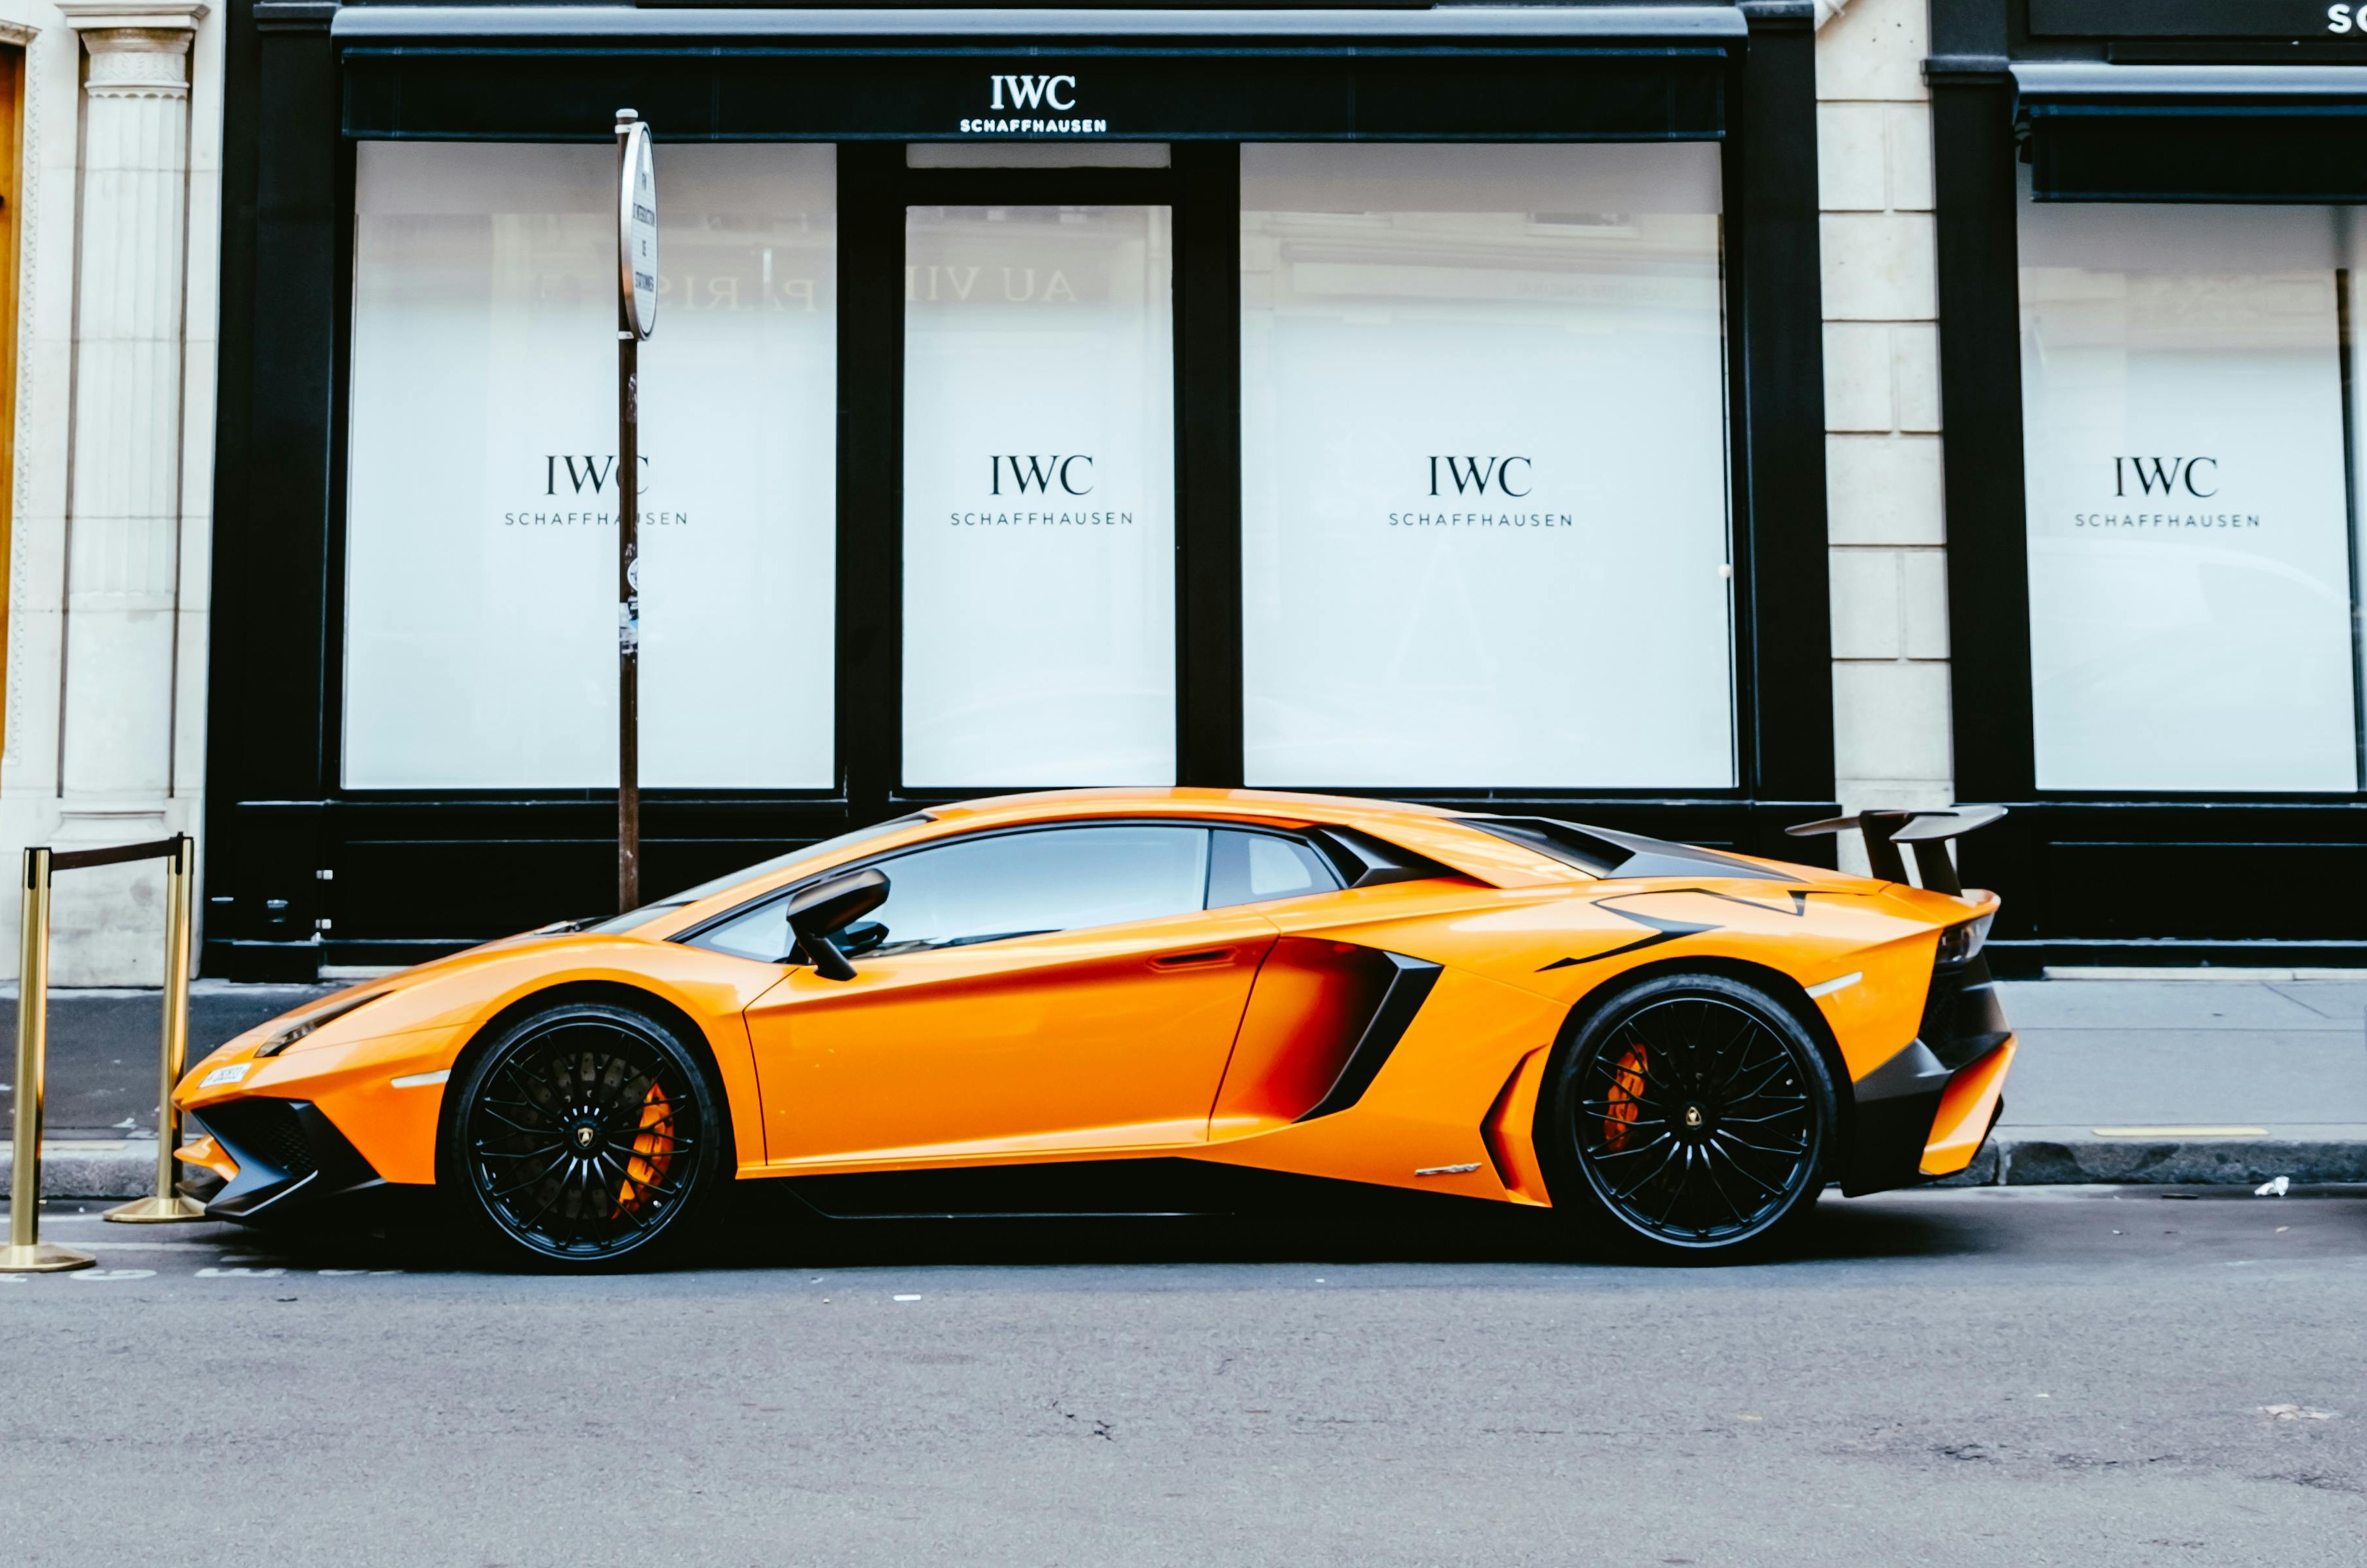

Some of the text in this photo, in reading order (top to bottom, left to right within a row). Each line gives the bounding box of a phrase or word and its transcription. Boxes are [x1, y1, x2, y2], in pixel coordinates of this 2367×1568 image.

[990, 74, 1076, 111] IWC
[960, 119, 1107, 132] SCHAFFHAUSEN
[989, 455, 1094, 496] IWC
[1427, 455, 1532, 497] IWC
[2113, 456, 2219, 497] IWC
[505, 512, 688, 525] SCHAFFHSEN
[951, 512, 1132, 525] SCHAFFHAUSEN
[1389, 513, 1572, 527] SCHAFFHAUSEN
[2075, 514, 2260, 527] SCHAFFHAUSEN
